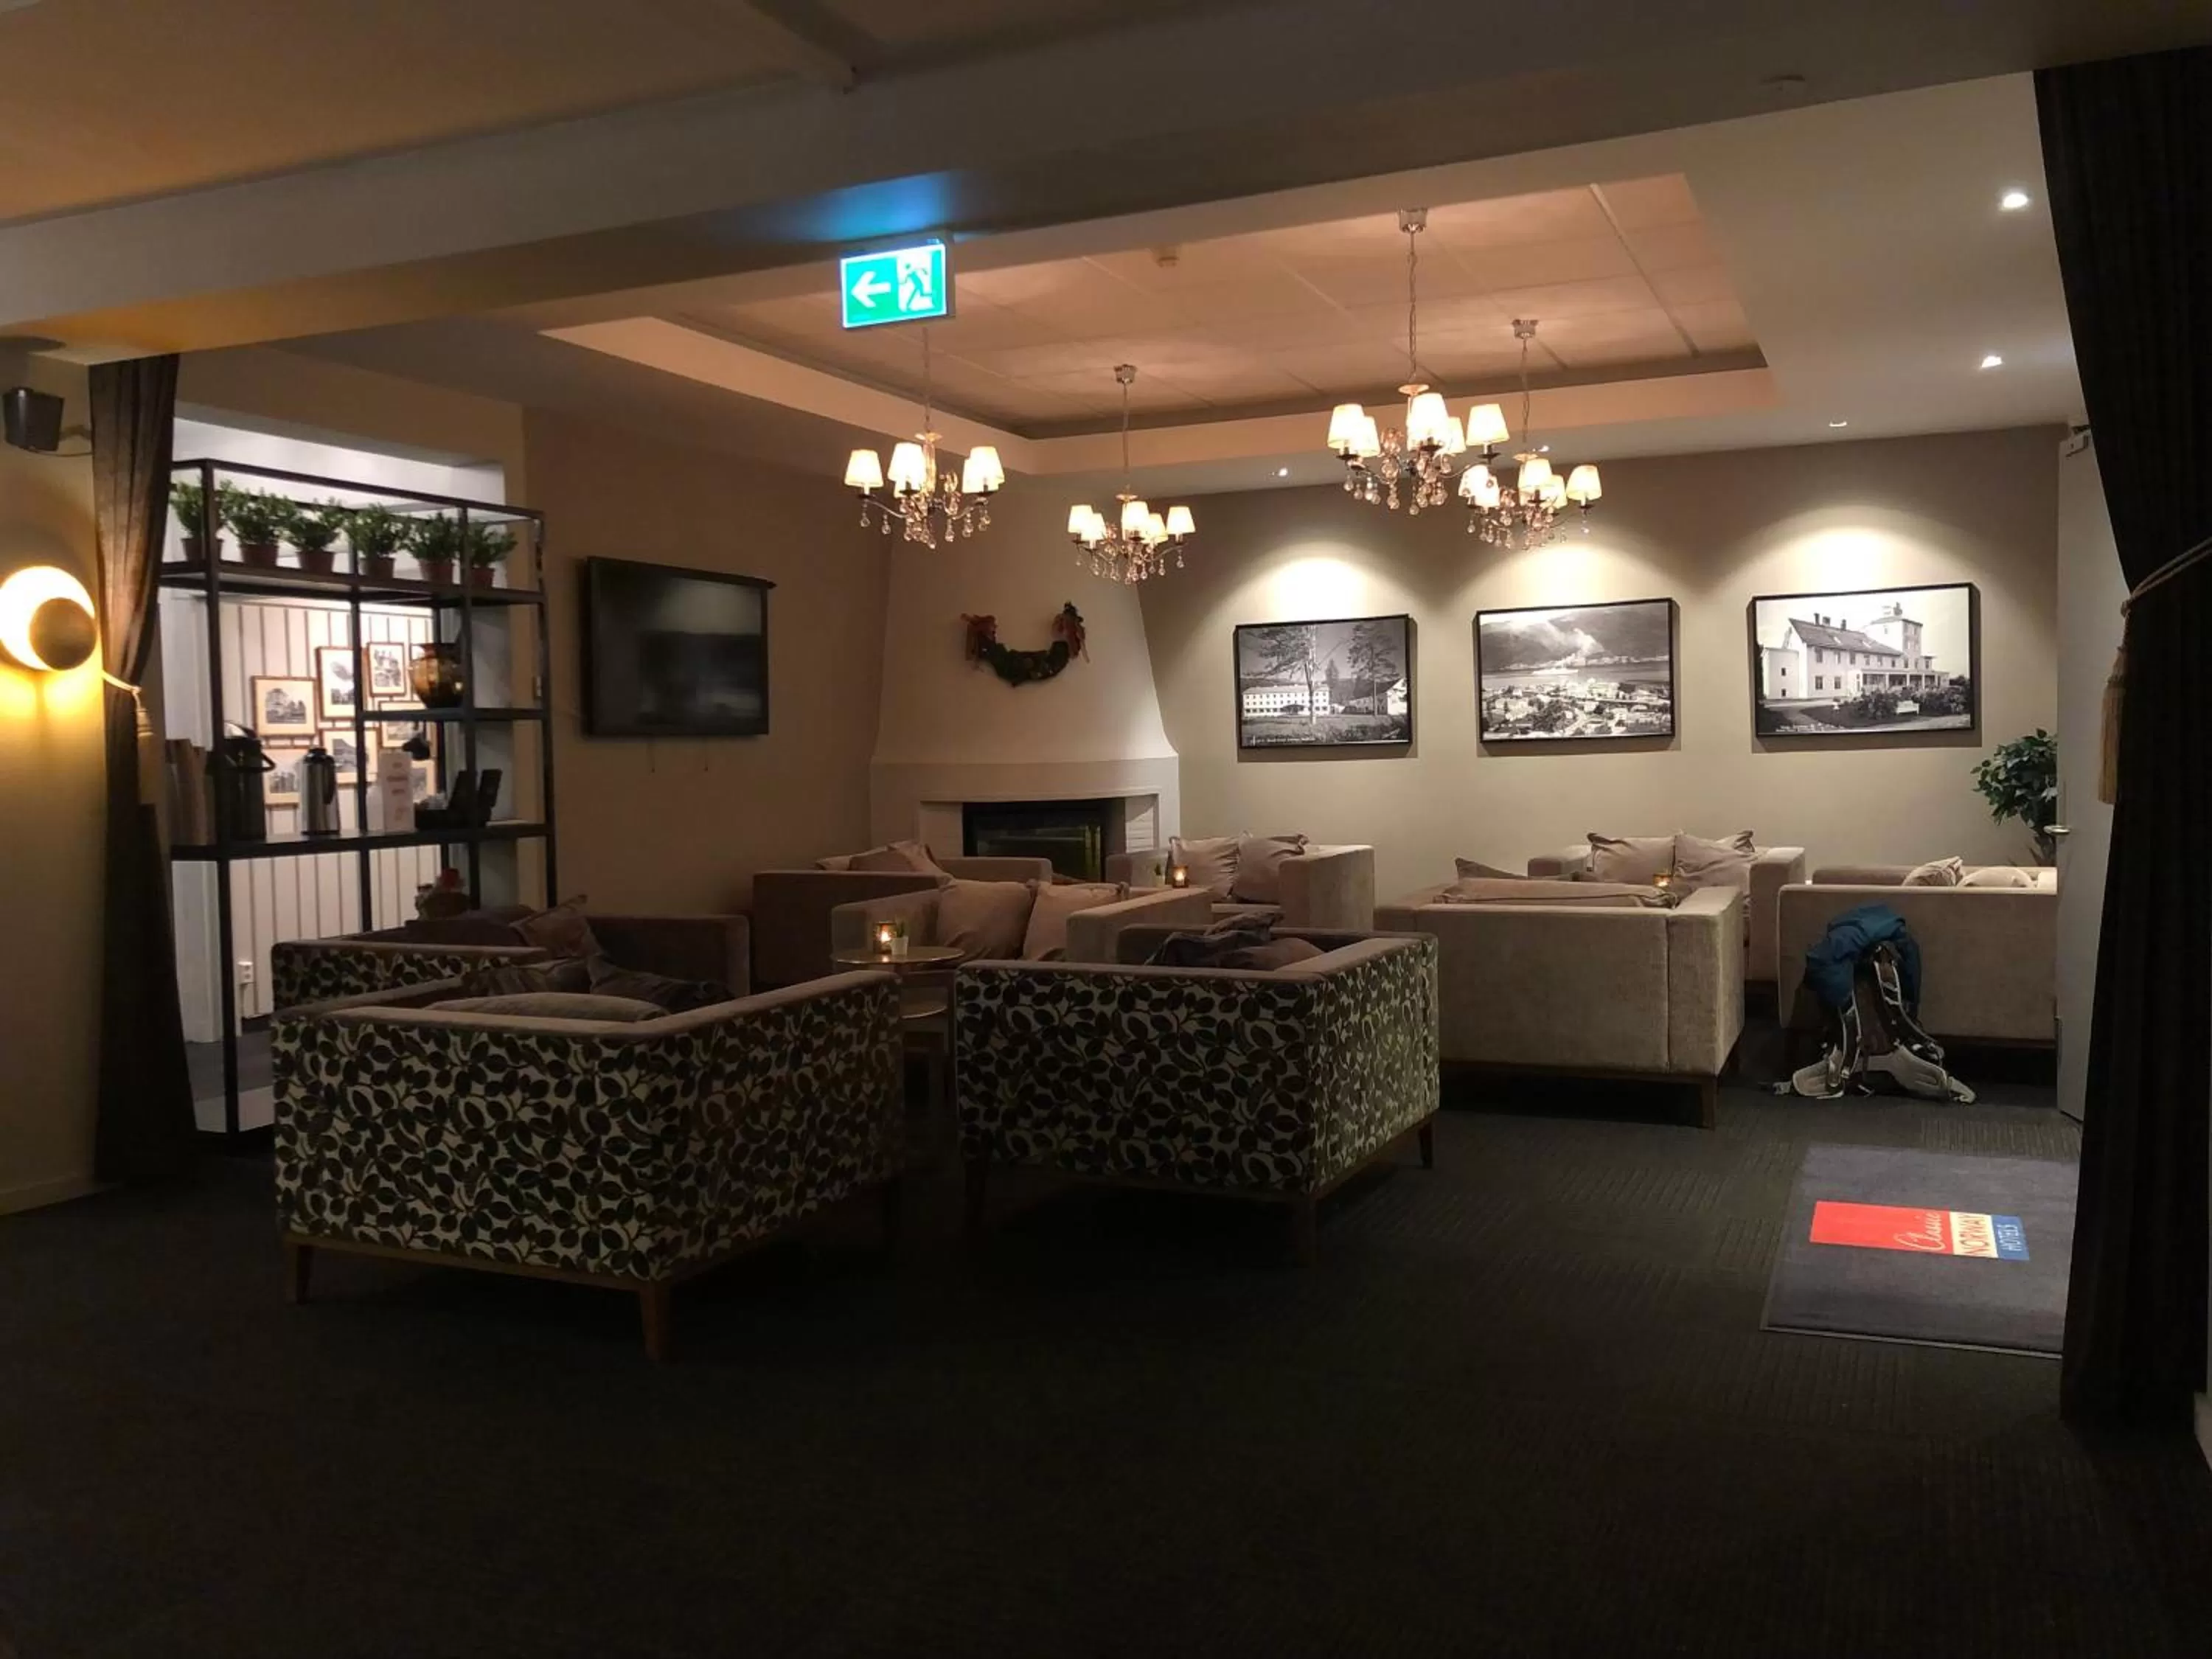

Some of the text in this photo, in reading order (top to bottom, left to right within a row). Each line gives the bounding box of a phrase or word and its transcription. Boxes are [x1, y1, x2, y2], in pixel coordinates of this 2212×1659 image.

[1893, 1211, 1947, 1251] Classic
[1958, 1213, 1992, 1257] NORWAY
[1996, 1223, 2023, 1252] HOTELS
